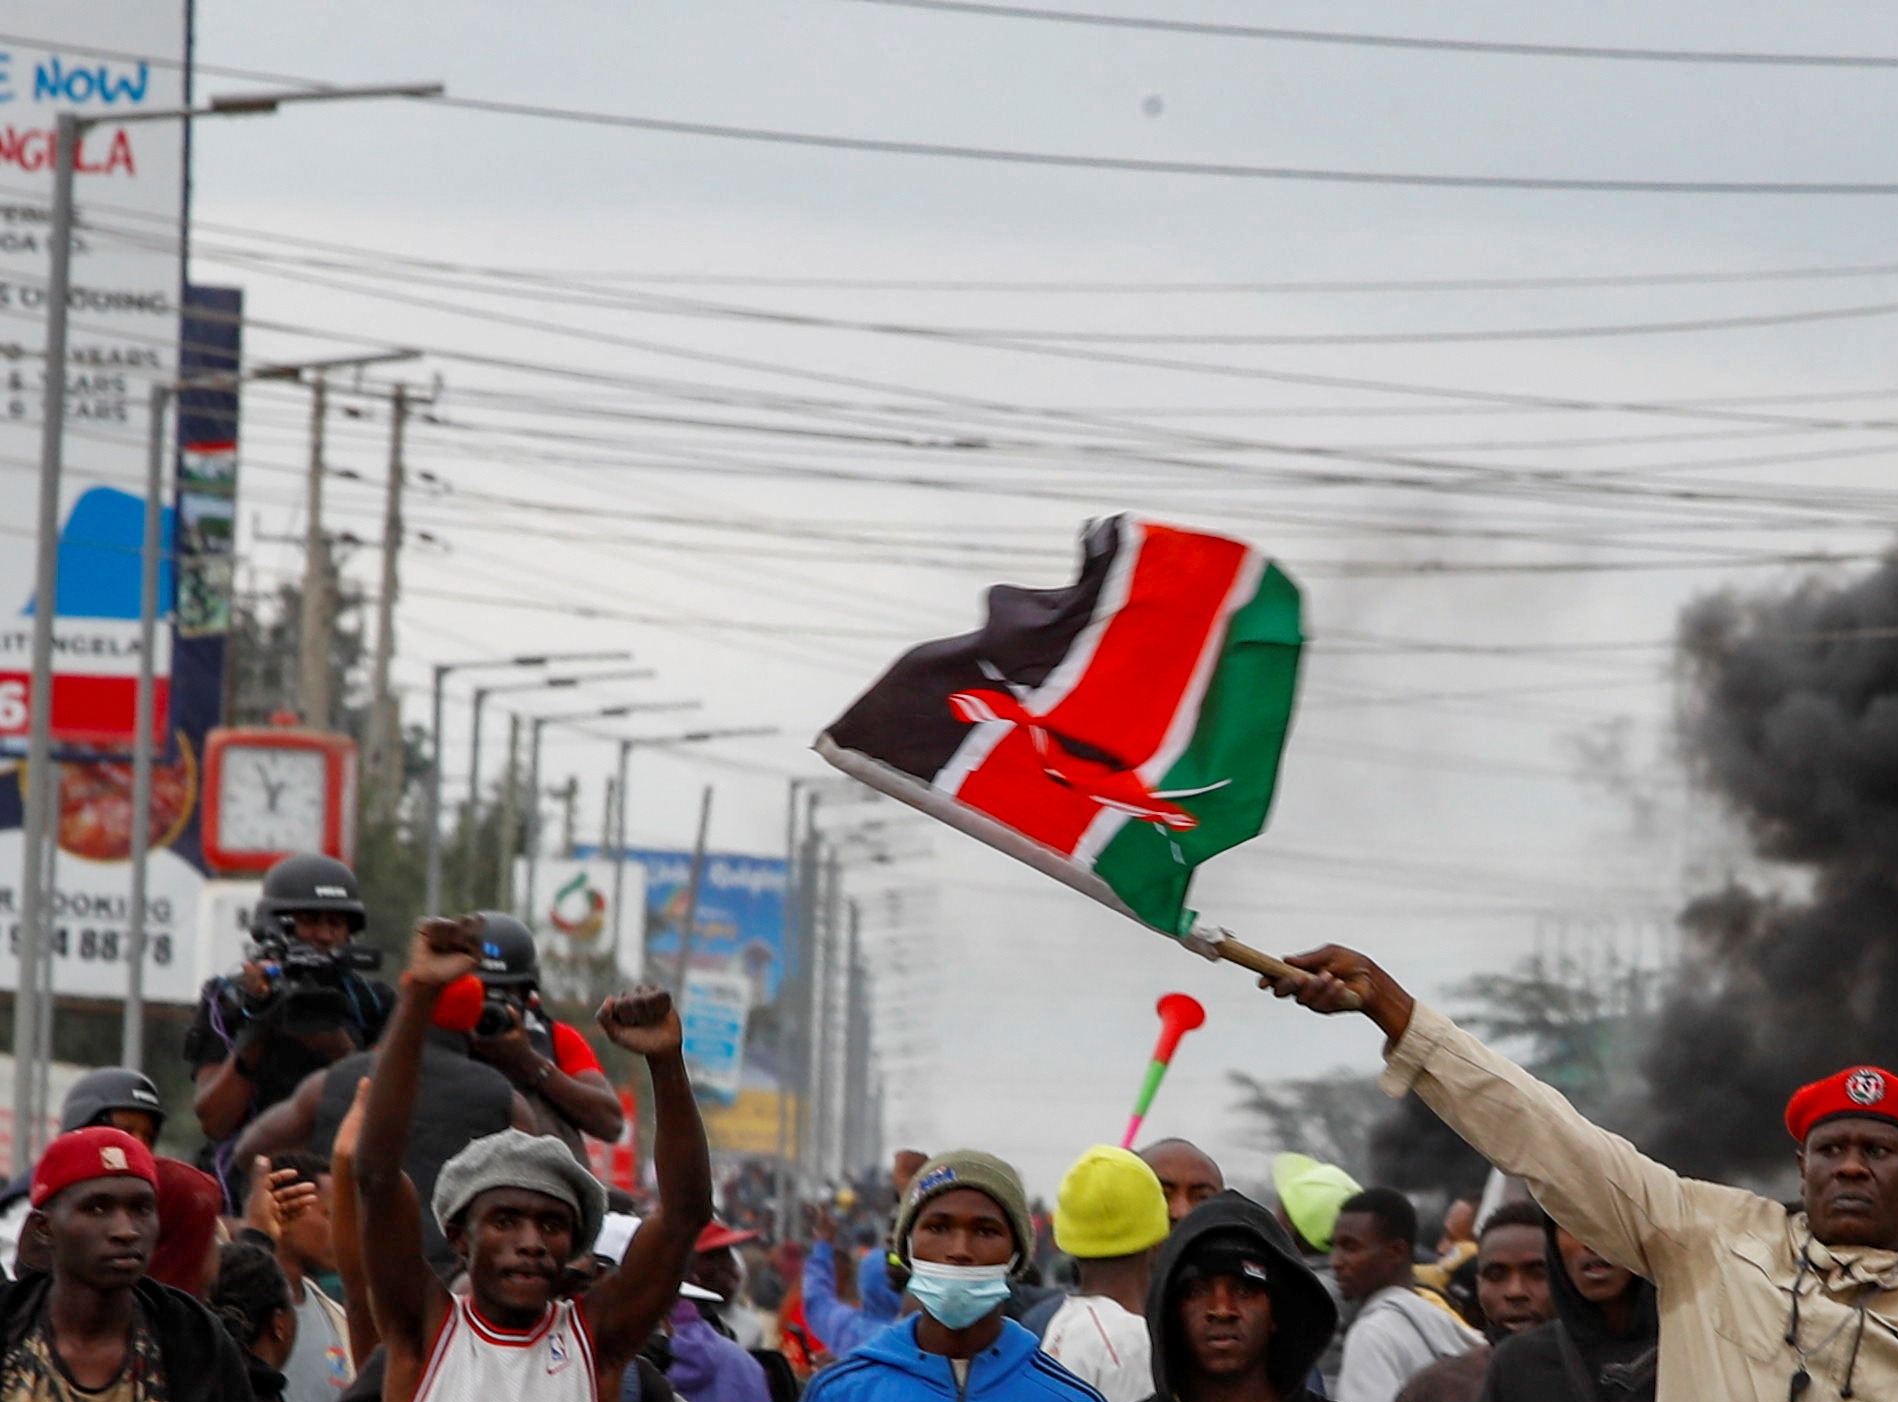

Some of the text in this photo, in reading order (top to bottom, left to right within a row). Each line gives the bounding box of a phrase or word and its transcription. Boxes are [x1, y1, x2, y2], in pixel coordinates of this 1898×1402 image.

[34, 56, 149, 104] NOW
[40, 888, 172, 924] OOKIG
[79, 927, 173, 966] 888
